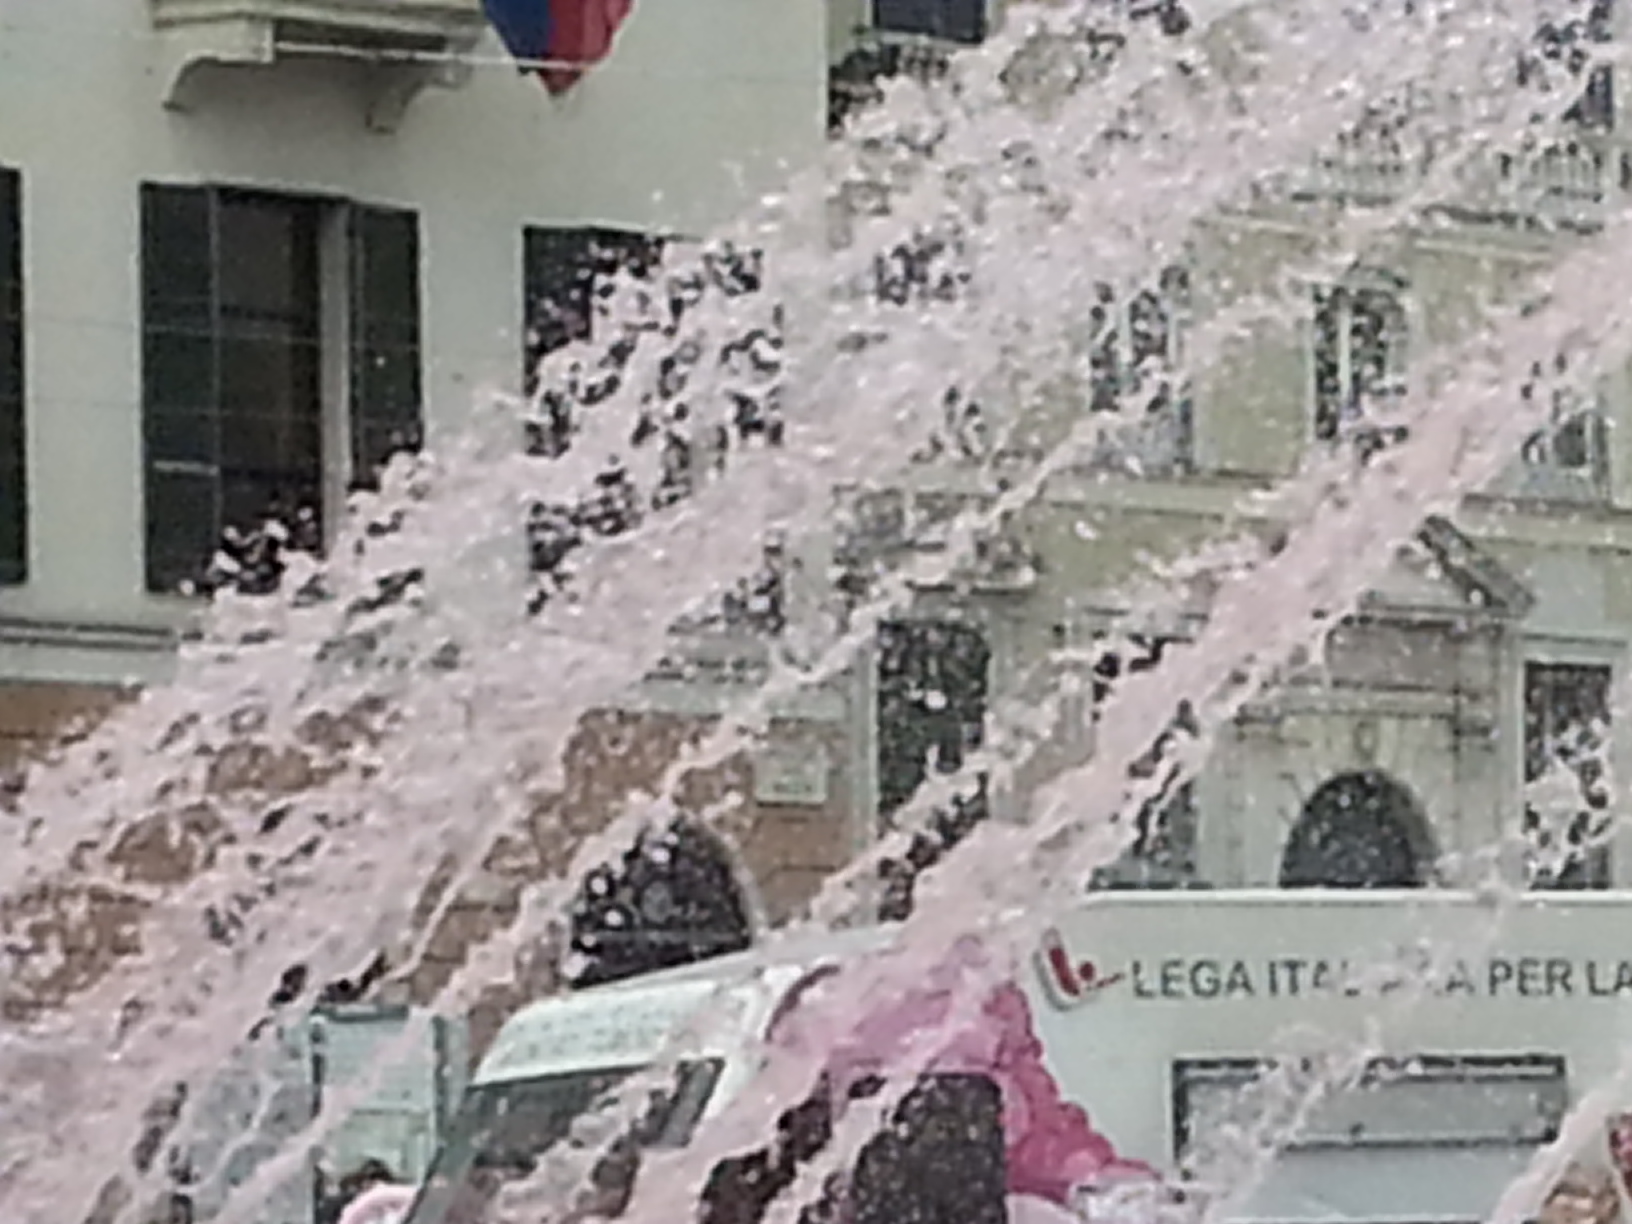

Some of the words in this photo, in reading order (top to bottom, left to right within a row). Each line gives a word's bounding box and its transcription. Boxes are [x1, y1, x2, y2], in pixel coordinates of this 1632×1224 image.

[1131, 958, 1254, 999] LEGA
[1268, 958, 1476, 999] ITALA
[1488, 957, 1573, 999] PER
